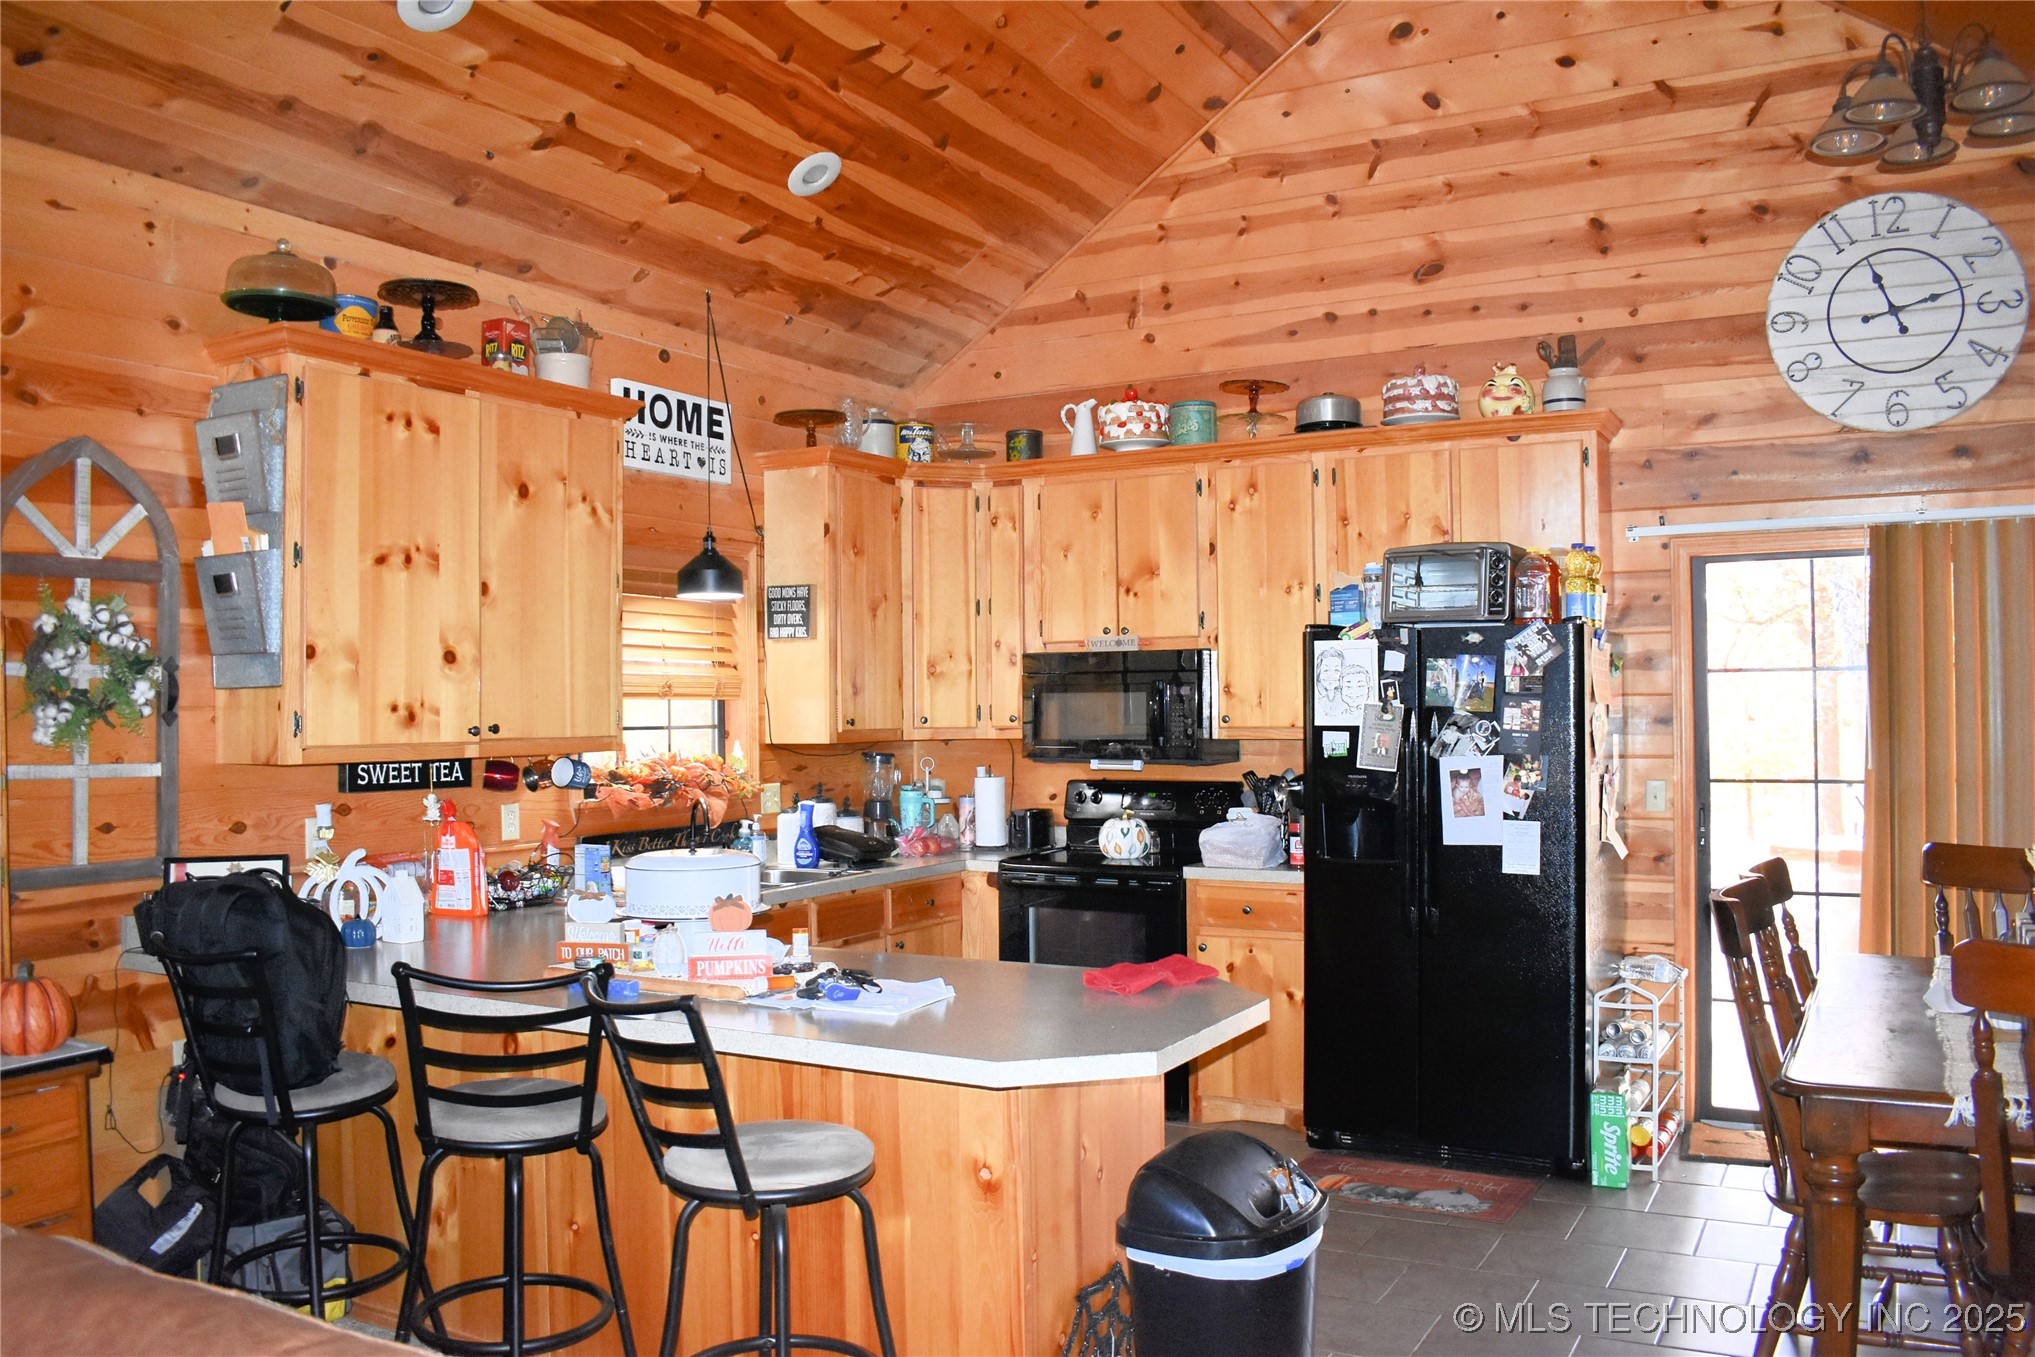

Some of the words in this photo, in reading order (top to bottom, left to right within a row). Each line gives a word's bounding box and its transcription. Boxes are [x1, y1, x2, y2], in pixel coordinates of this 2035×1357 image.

[1868, 195, 1910, 238] 12
[1930, 203, 1957, 239] 1
[1818, 213, 1858, 255] 11
[1962, 236, 2003, 273] 2
[1777, 253, 1822, 294] 10
[1976, 289, 2024, 314] 3
[1770, 310, 1809, 334] 9
[511, 343, 525, 359] RITZ
[1967, 339, 2009, 368] 4
[1787, 352, 1822, 382] 8
[1831, 379, 1865, 417] 7
[1935, 369, 1967, 409] 5
[1886, 390, 1909, 427] 6
[660, 434, 688, 447] WHERE
[691, 440, 705, 452] THE
[625, 440, 692, 470] HEART
[710, 457, 726, 476] IS
[769, 587, 781, 598] GOOD
[782, 586, 796, 598] MOMS
[797, 586, 809, 598] HAVE
[771, 600, 786, 611] STICKY
[773, 613, 786, 625] DIRTY
[357, 763, 422, 785] SWEET
[429, 761, 464, 782] TEA
[612, 840, 635, 857] Kiss
[638, 836, 672, 851] Better
[674, 829, 702, 848] Thn
[567, 925, 616, 941] Welcome
[560, 946, 572, 959] TO
[576, 947, 593, 957] OUR
[598, 947, 625, 960] PATCH
[696, 958, 767, 977] PUMPKINS
[1600, 1121, 1622, 1175] Sprite
